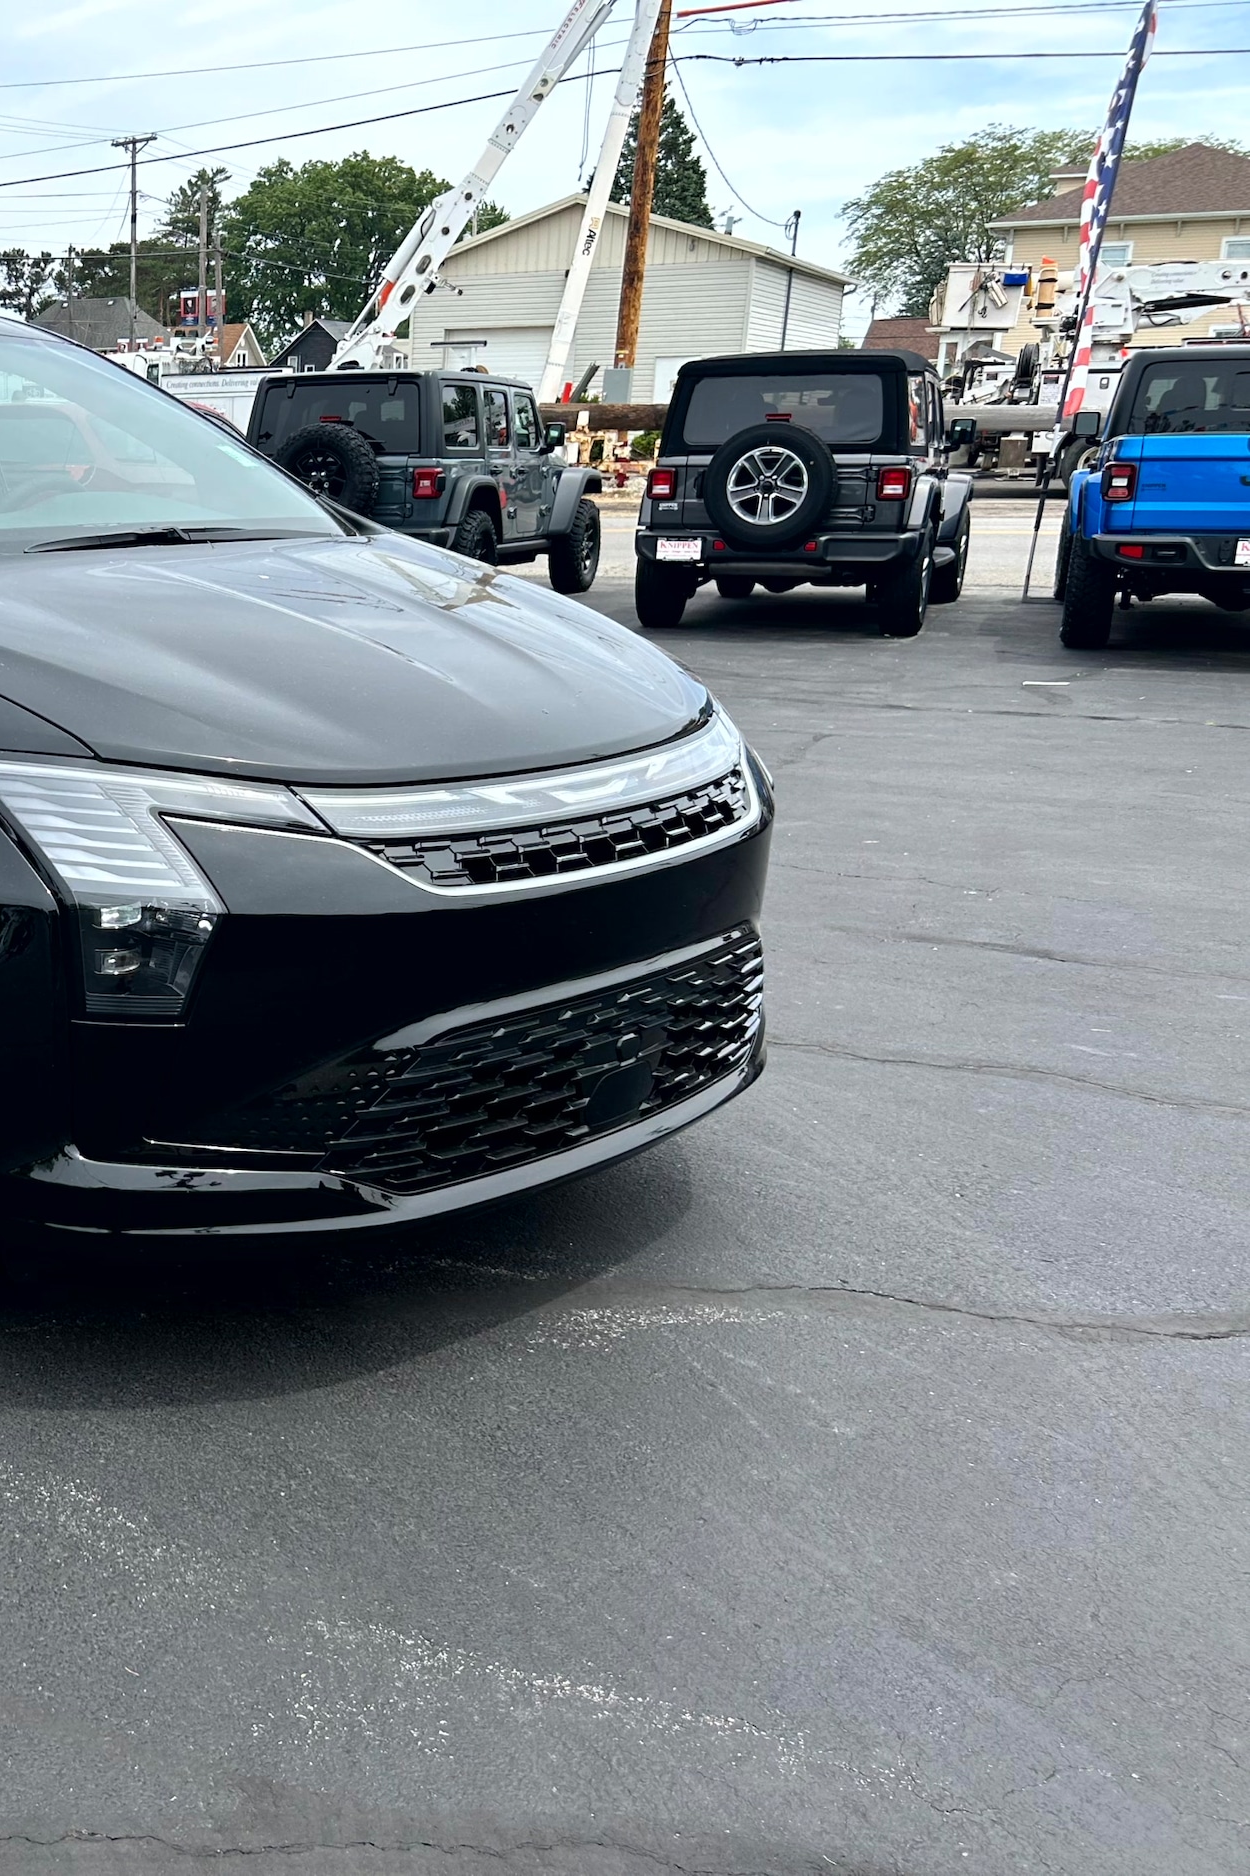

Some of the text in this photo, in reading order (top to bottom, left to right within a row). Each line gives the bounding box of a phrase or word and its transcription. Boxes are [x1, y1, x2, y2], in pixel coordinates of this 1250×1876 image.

[582, 228, 597, 256] Altec
[166, 381, 188, 390] Creating
[221, 378, 249, 388] Delivering
[660, 541, 699, 549] KNIPPEN
